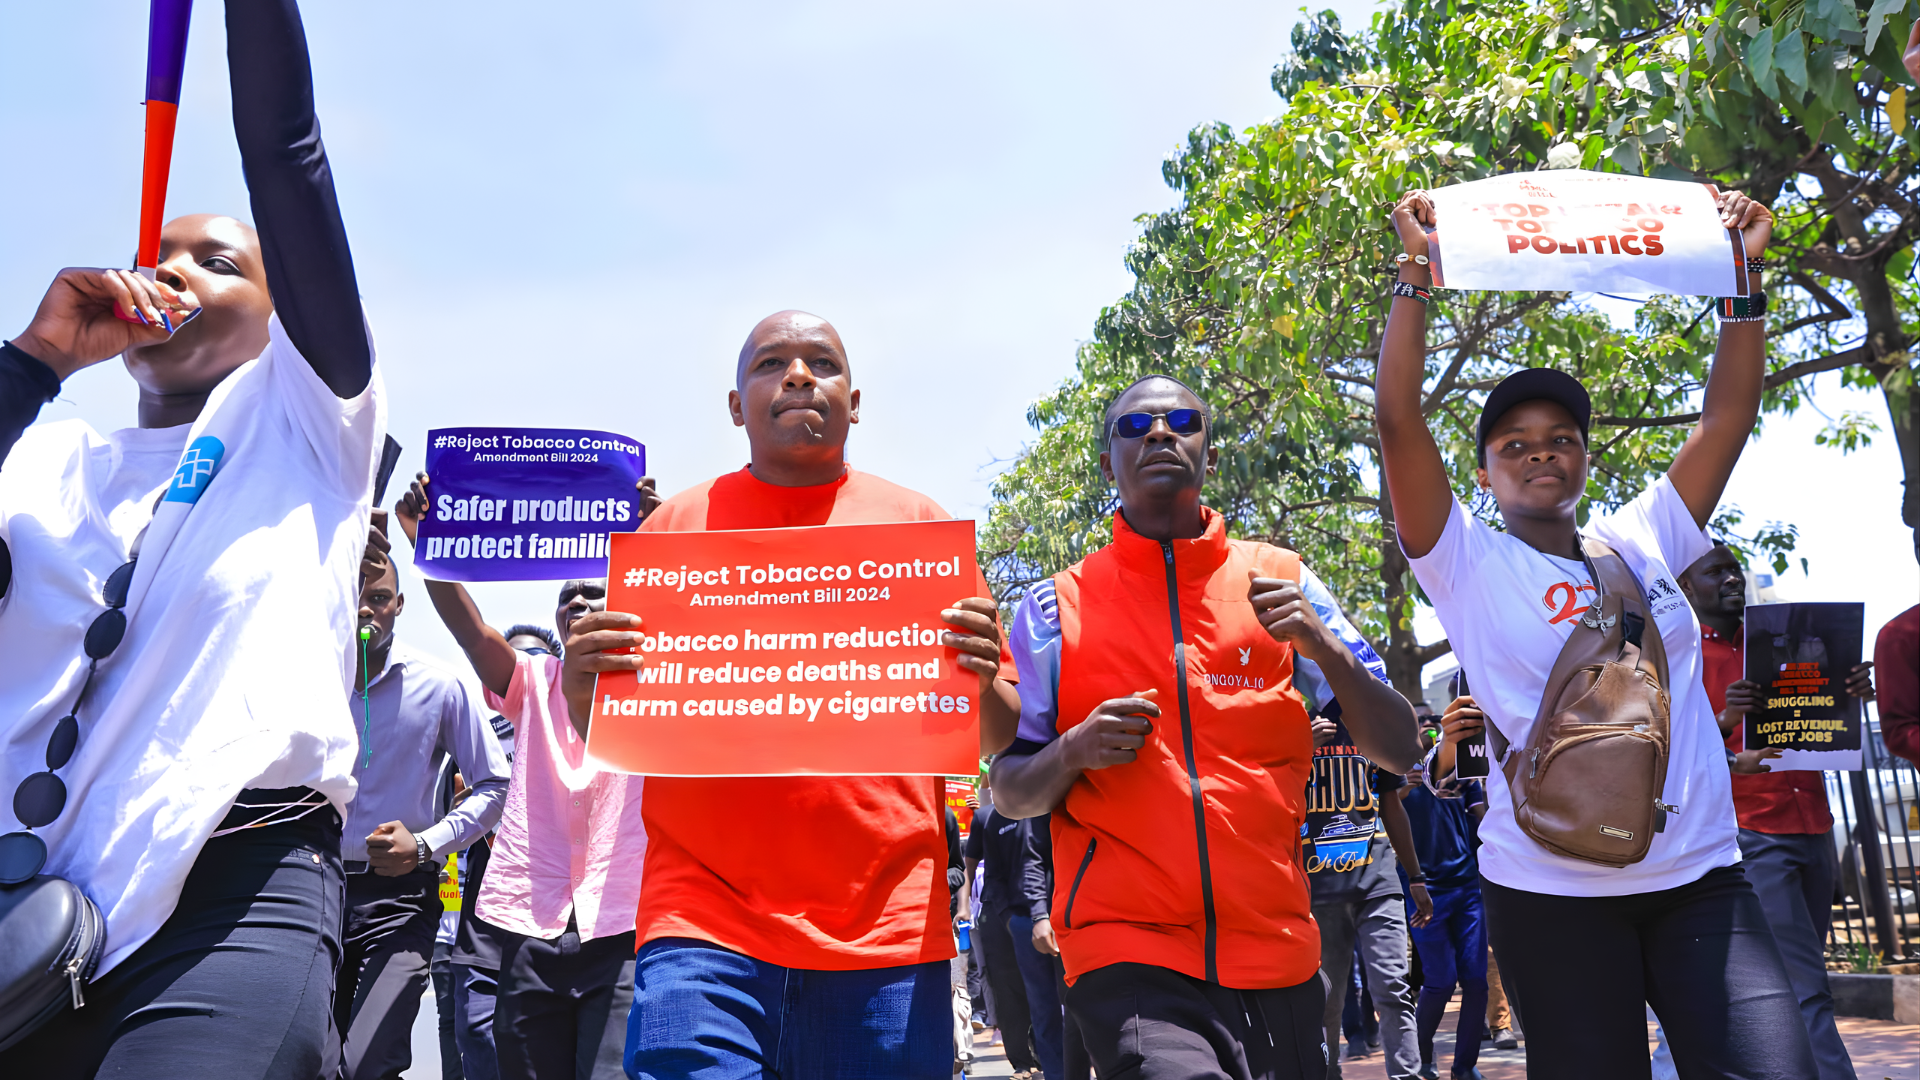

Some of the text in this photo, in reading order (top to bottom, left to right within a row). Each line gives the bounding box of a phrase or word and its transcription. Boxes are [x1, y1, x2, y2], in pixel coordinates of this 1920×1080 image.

[1507, 234, 1664, 256] POLITICS
[434, 434, 640, 457] #Reject Tobacco Control
[473, 452, 599, 463] Amendment Bill 2024
[437, 494, 631, 524] Safer products
[425, 533, 609, 561] protect famili
[623, 556, 960, 593] #Reject Tobacco Control
[689, 586, 891, 607] Amendment Bill 2024
[630, 631, 739, 653] obacco
[743, 629, 817, 650] harm
[636, 657, 940, 684] will reduce deaths and
[602, 689, 971, 722] harm caused by cigarettes
[1757, 722, 1783, 734] LOST
[1768, 731, 1833, 745] LOST JOBS
